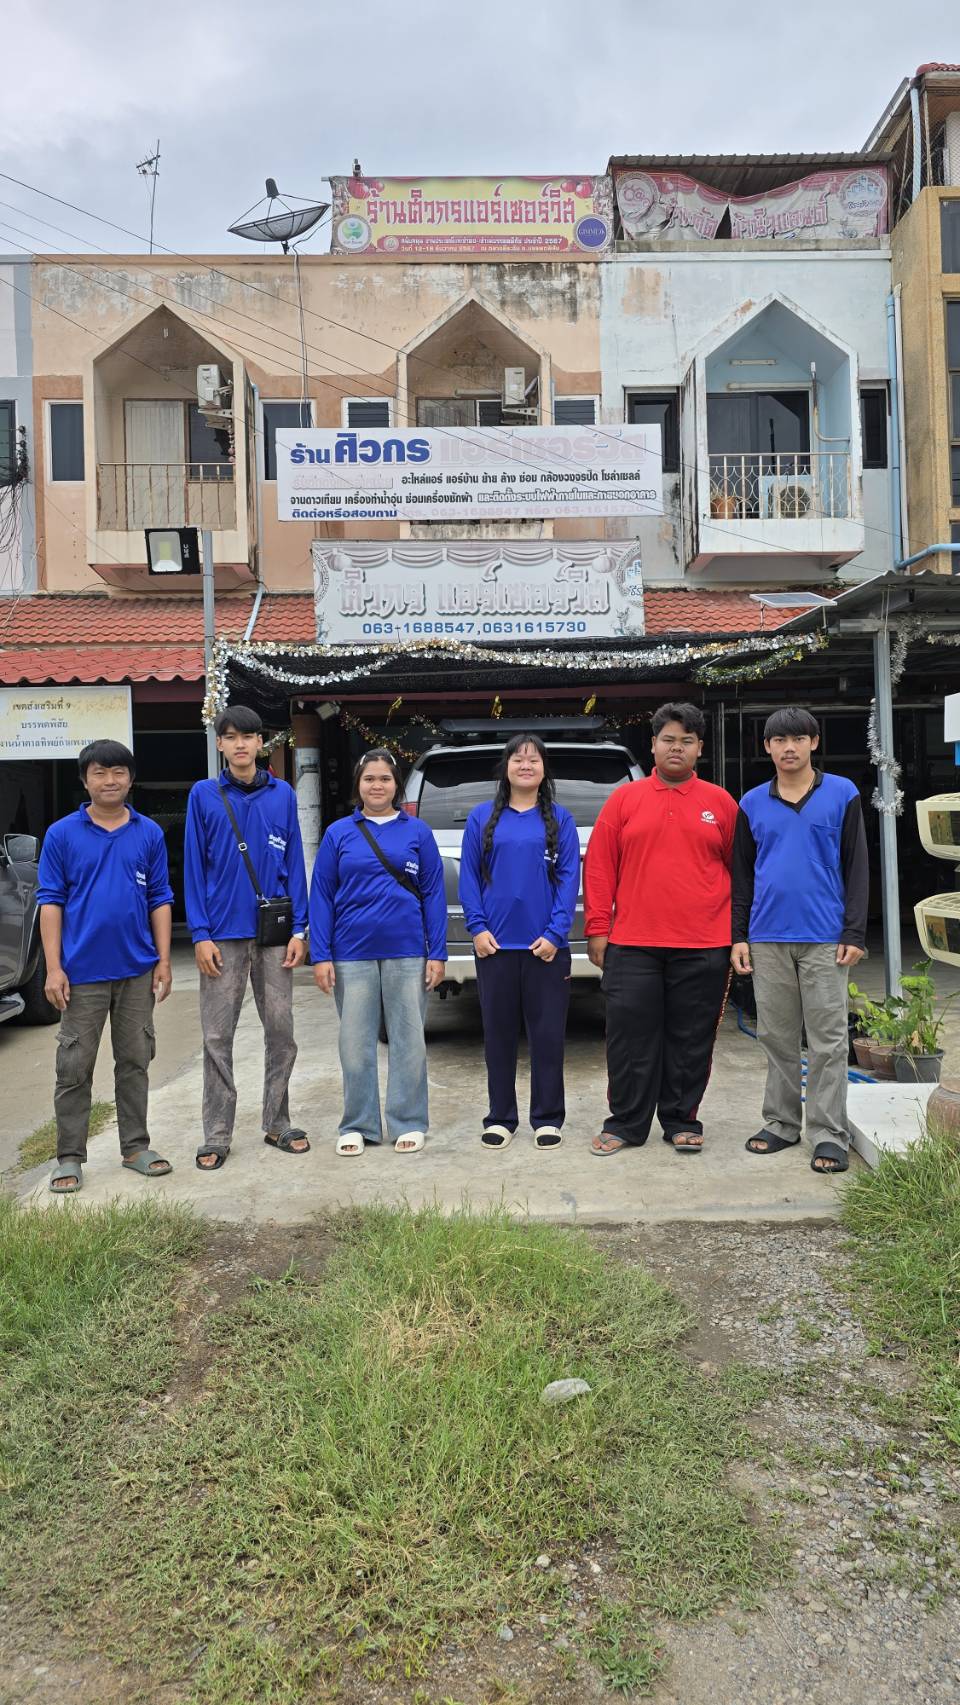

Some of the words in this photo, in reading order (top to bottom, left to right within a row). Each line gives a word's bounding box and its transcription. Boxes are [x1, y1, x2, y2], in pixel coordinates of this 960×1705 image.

[290, 443, 330, 464] ร้าน
[334, 432, 430, 463] ศิวกร
[446, 472, 479, 484] แอร์บ้าน
[482, 472, 497, 483] ย้าย
[501, 472, 516, 483] ล้าง
[519, 472, 537, 483] ซ่อม
[541, 470, 599, 482] กล้องวงจรปิด
[291, 493, 342, 505] จานดาวเทียม
[345, 491, 402, 507] เครื่องทำน้ำอุ่น
[406, 490, 473, 504] ซ่อมเครื่องซักผ้า
[292, 508, 398, 518] ติดต่อหรือสอบถาม
[362, 621, 587, 635] 063-1688547,0631615730
[12, 697, 64, 711] เขตส่งเสริมที่
[21, 718, 68, 729] บรรพตพิสัย
